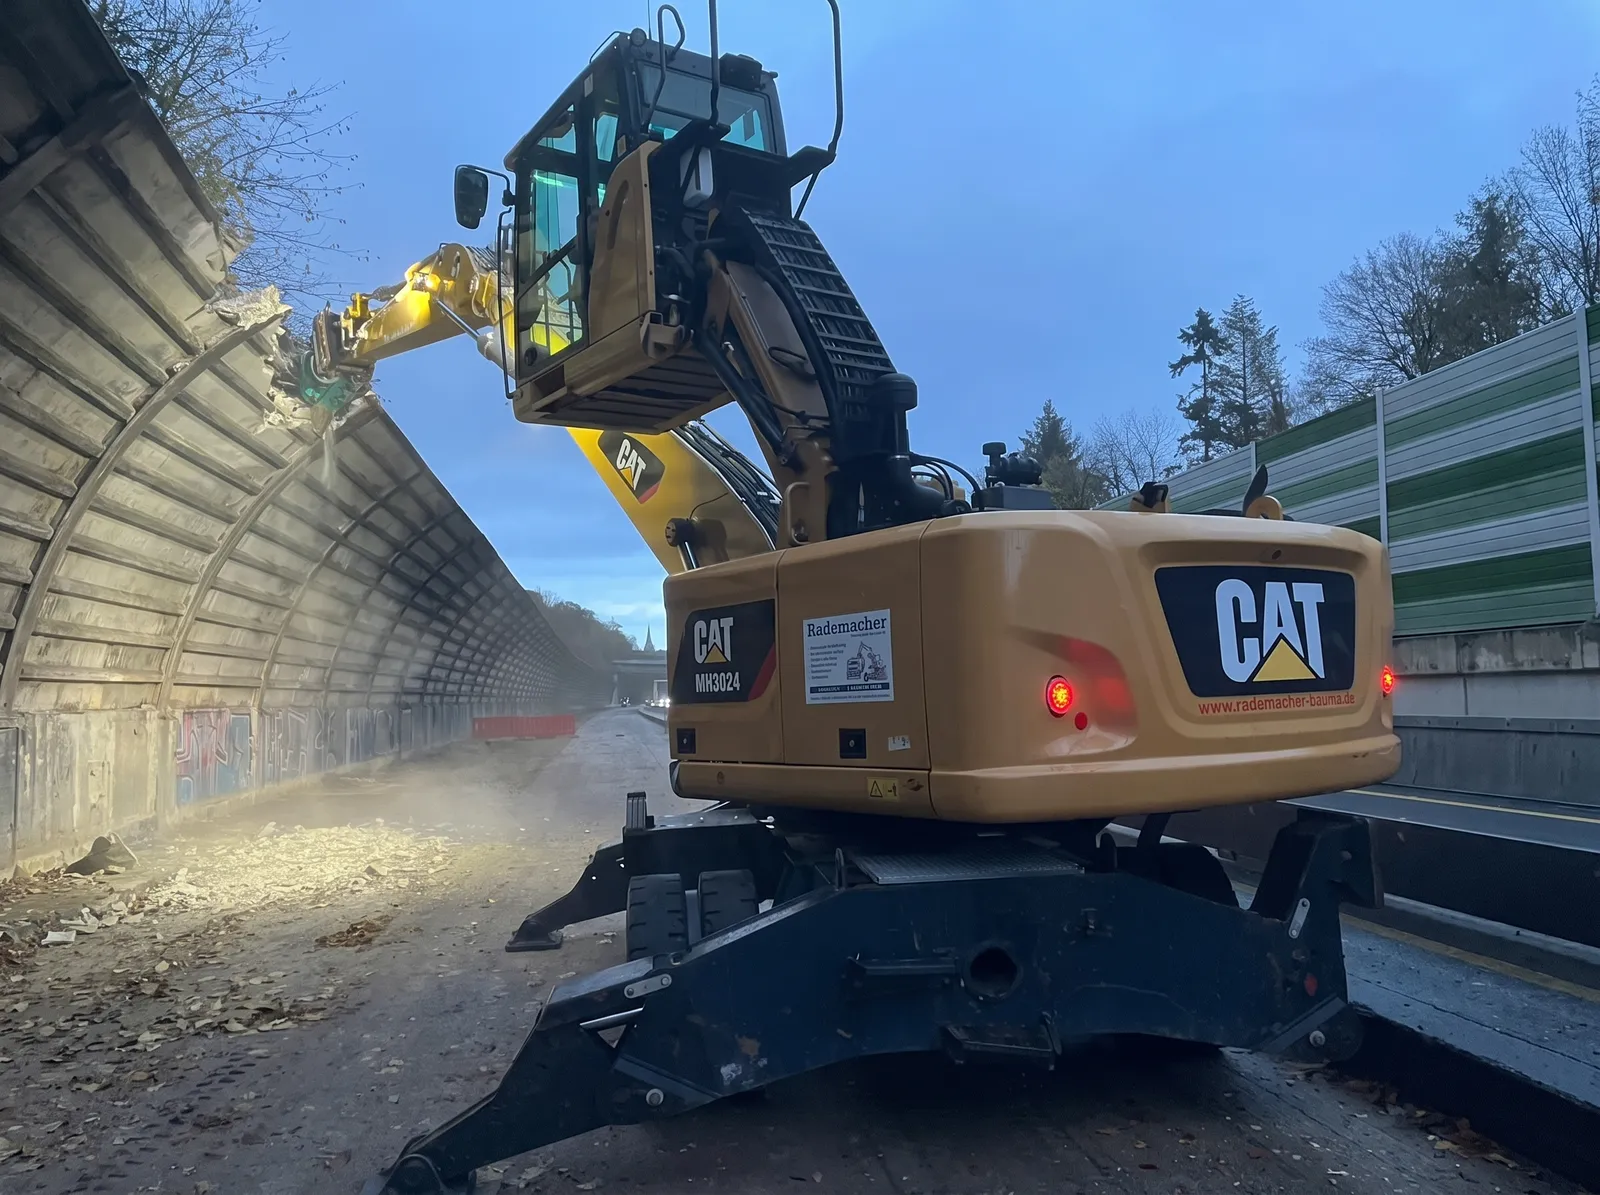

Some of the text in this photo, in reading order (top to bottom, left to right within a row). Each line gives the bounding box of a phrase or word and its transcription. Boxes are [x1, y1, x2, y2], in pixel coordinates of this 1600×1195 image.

[616, 438, 647, 491] CAT
[693, 616, 733, 664] CAT
[807, 616, 887, 637] Rademacher
[1215, 578, 1325, 683] CAT
[695, 671, 741, 693] MH3024
[1198, 692, 1356, 715] www.rademacher-bauma.de
